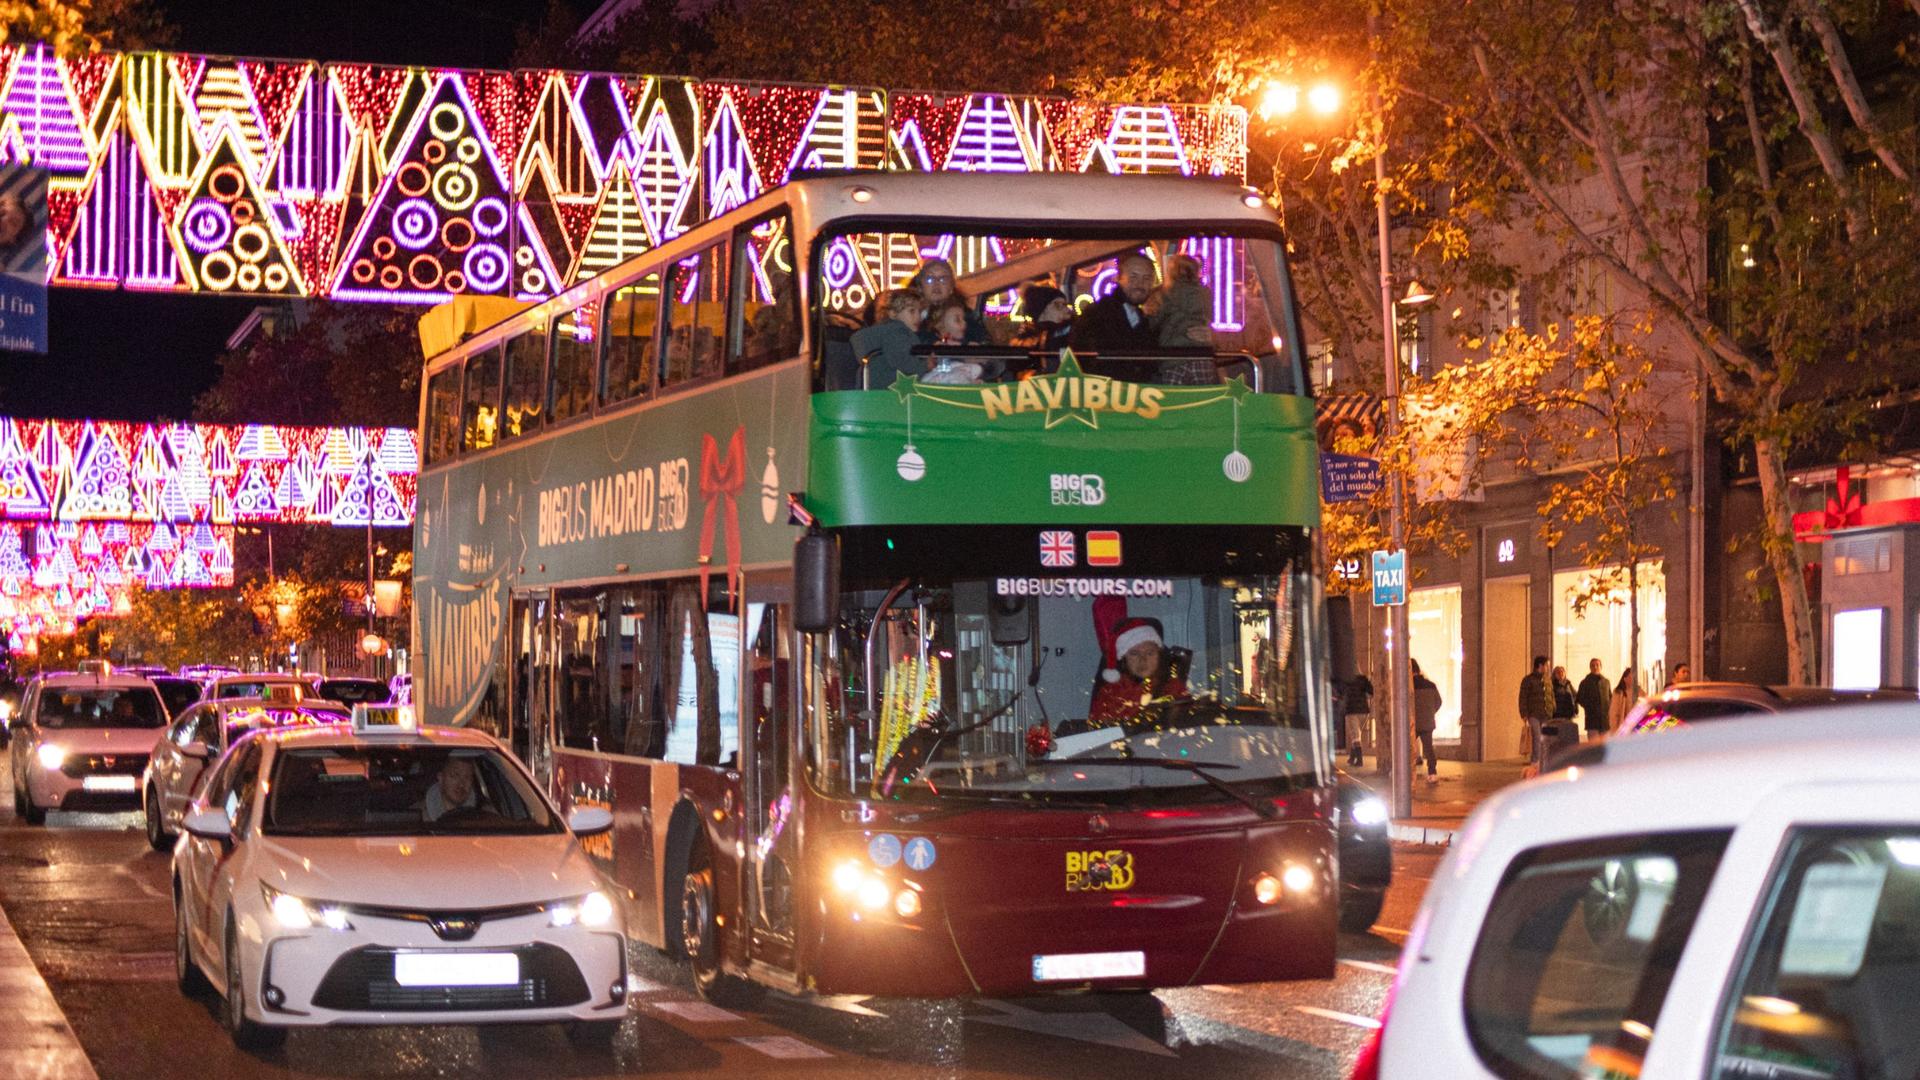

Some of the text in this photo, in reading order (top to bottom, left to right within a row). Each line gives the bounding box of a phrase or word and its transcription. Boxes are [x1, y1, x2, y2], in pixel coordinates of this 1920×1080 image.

[11, 295, 35, 314] fin
[0, 335, 35, 350] lejalde
[979, 377, 1165, 421] NAVIBUS
[659, 459, 678, 498] BIG
[1050, 474, 1081, 490] BIG
[1328, 471, 1347, 481] Tan
[1349, 470, 1367, 480] solo
[1329, 481, 1344, 493] del
[1051, 490, 1081, 505] BUS
[538, 466, 655, 548] BIGBUS MADRID
[996, 578, 1173, 596] BIGBUSTOURS.COM
[1375, 569, 1402, 587] TAXI
[428, 578, 500, 709] NAVIBUS
